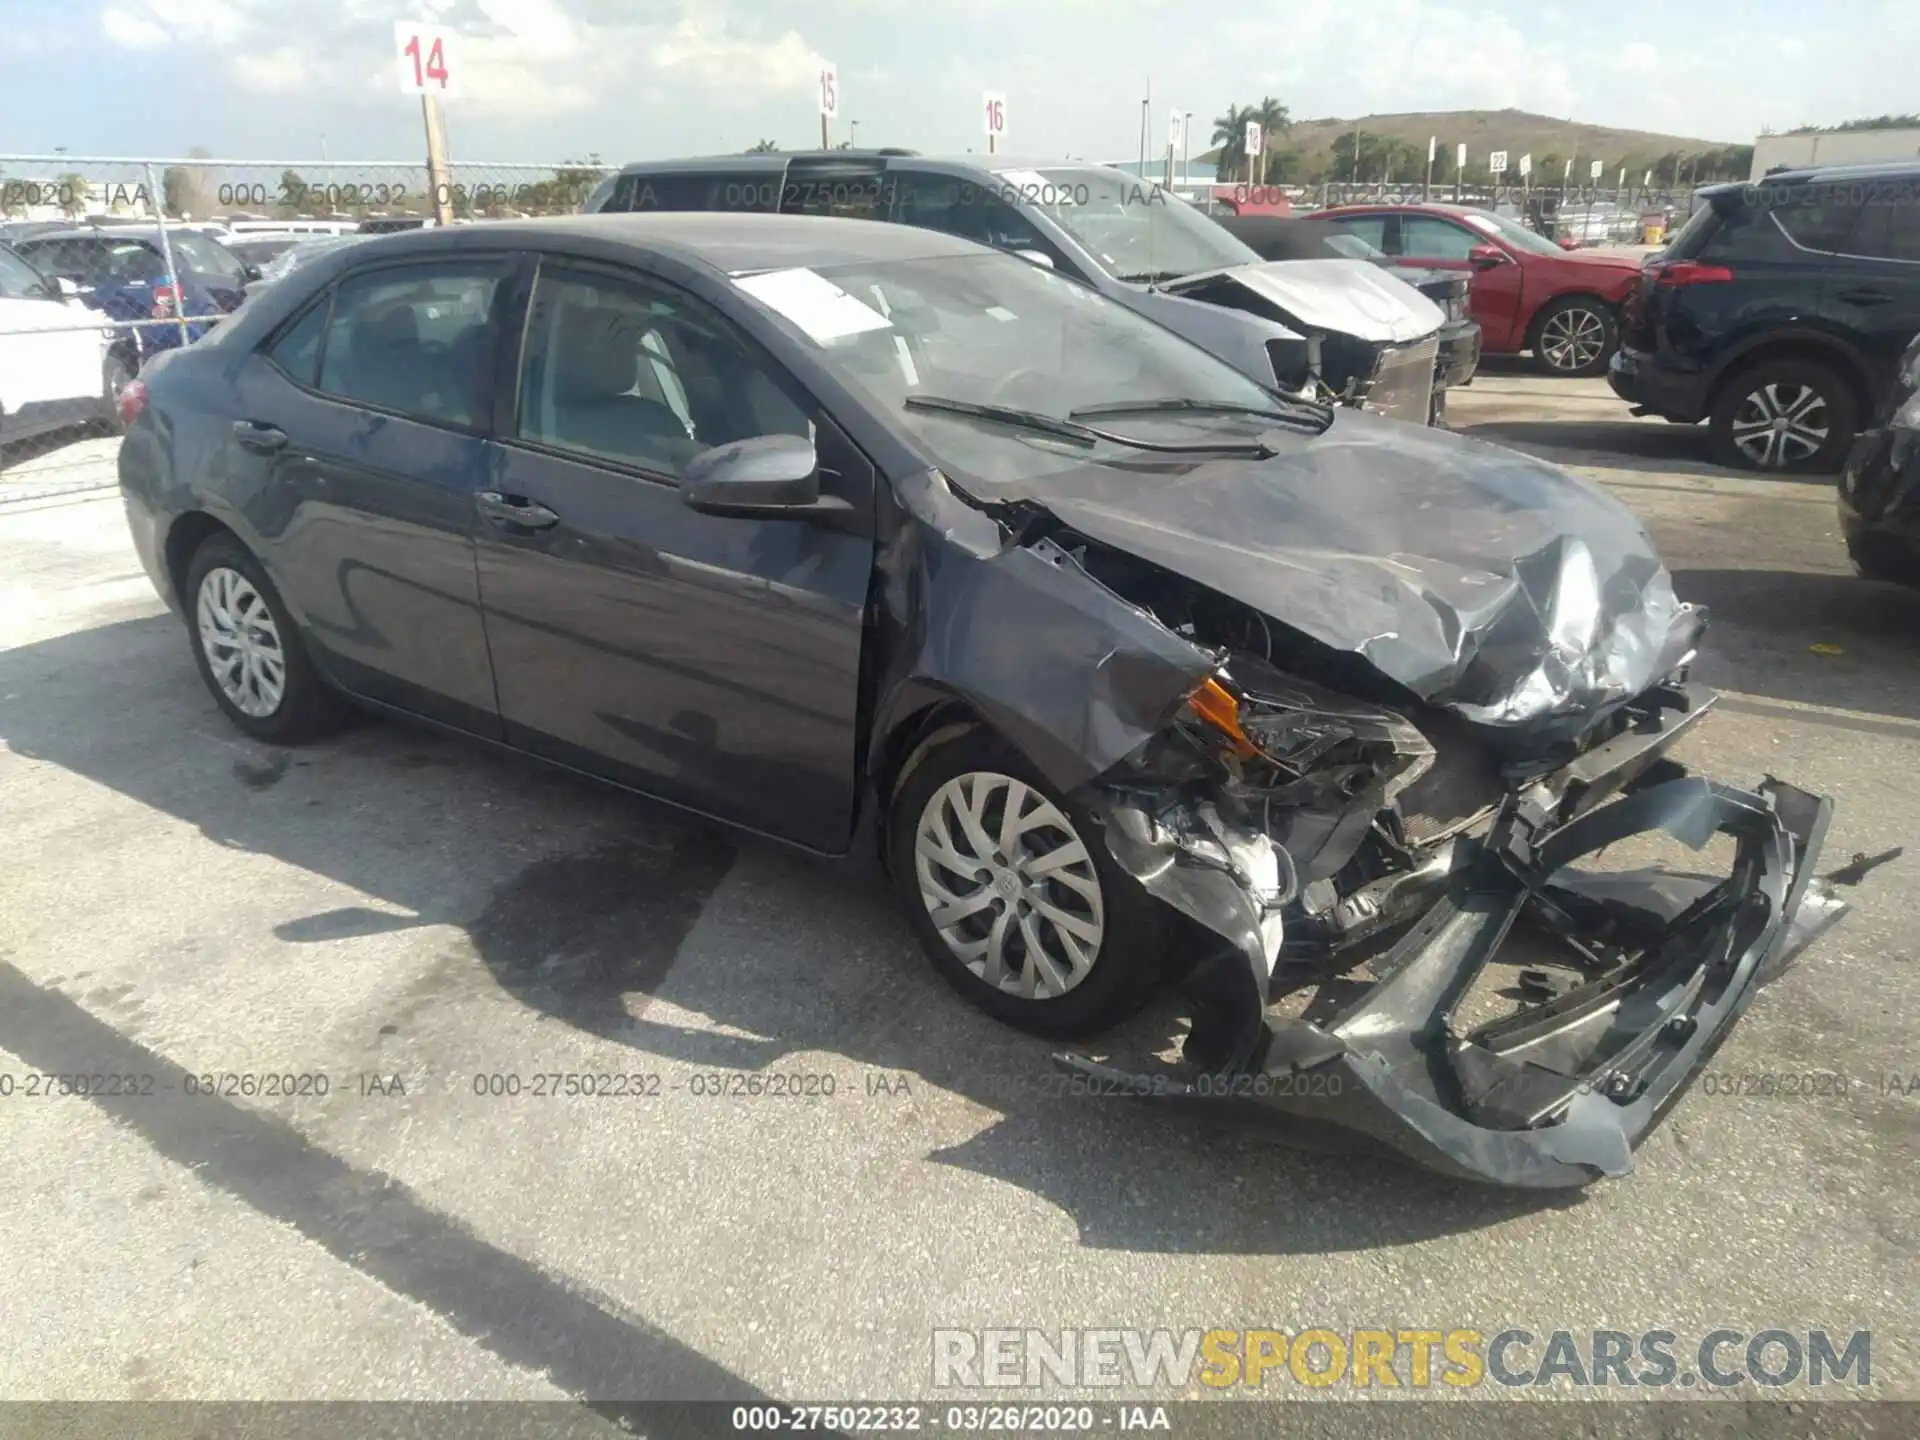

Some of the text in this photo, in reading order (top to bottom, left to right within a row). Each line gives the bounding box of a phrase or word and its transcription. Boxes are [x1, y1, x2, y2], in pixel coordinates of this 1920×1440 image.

[404, 35, 449, 89] 14
[820, 69, 835, 112] 15
[986, 99, 1004, 132] 16
